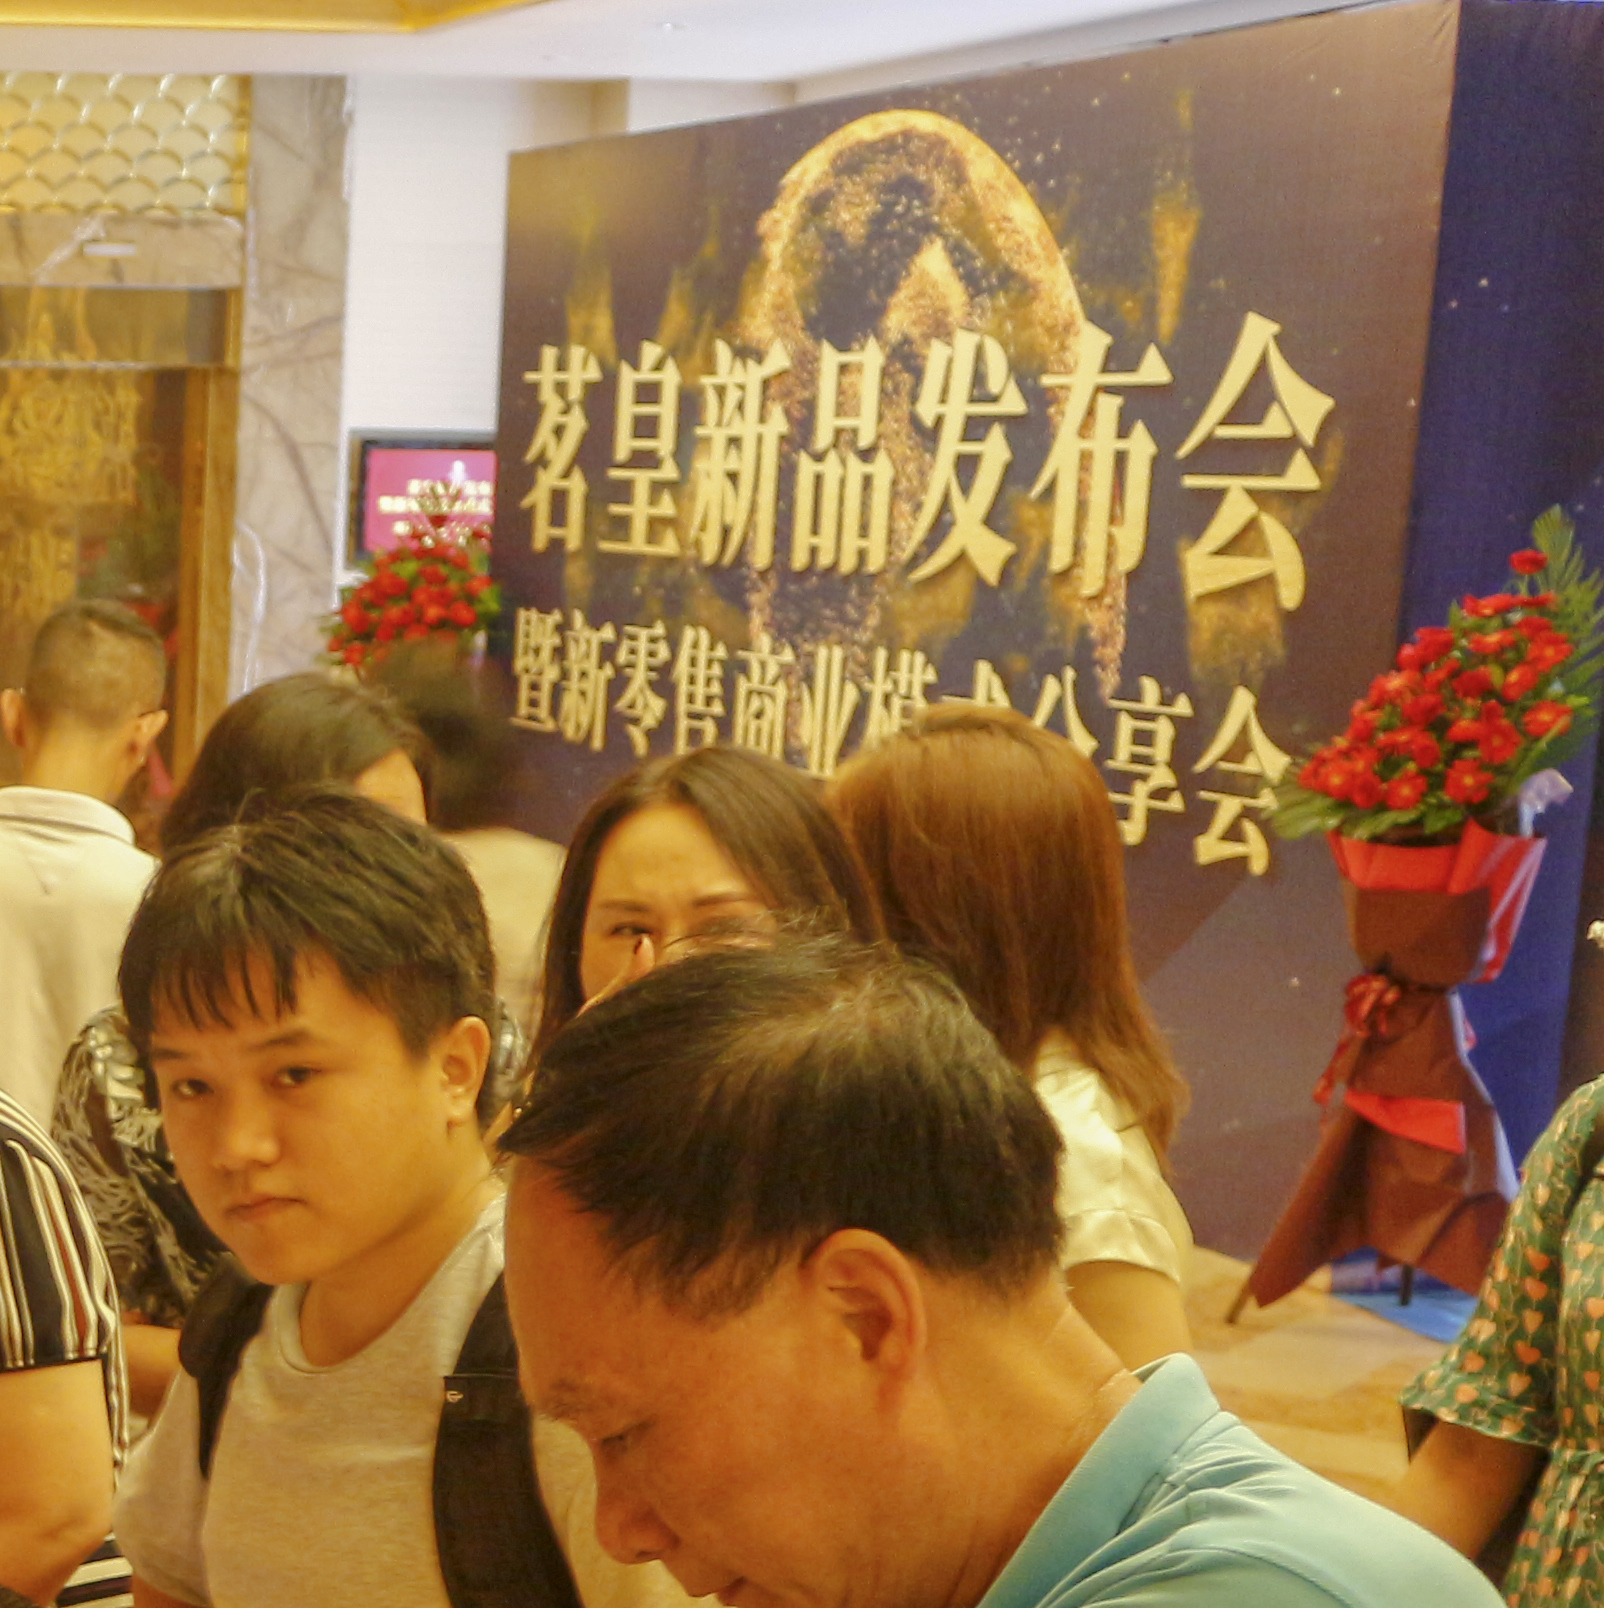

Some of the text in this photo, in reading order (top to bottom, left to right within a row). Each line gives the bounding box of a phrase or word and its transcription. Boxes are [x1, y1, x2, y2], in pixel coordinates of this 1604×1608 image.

[518, 309, 1336, 612] 茗皇新品发布会
